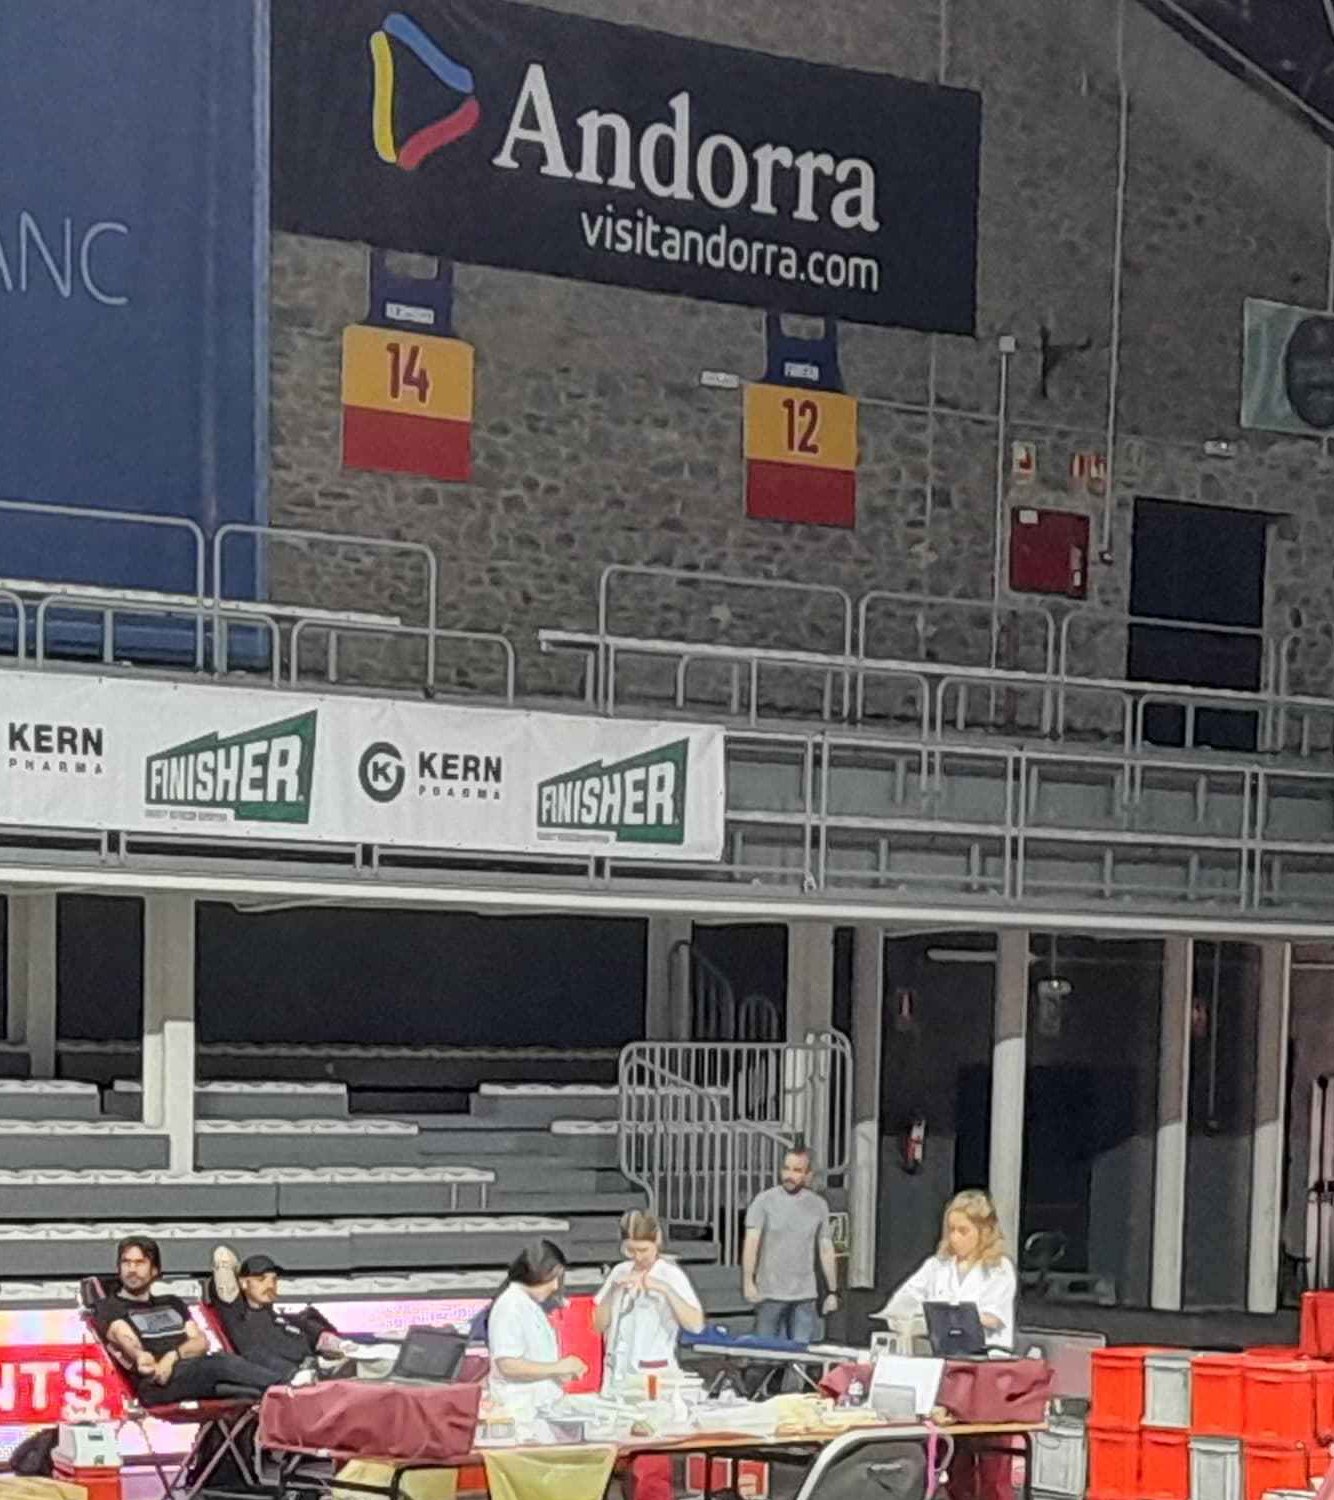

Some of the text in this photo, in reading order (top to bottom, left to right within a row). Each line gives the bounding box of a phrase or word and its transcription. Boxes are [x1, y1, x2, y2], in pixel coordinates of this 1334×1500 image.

[491, 63, 880, 232] Andorra
[581, 203, 879, 293] visitandorra.com
[386, 342, 431, 404] 14
[782, 398, 820, 455] 12
[8, 722, 103, 756] KERN
[8, 757, 103, 775] PHARMA
[150, 735, 302, 802] FINISHER
[418, 751, 502, 783] KERN
[540, 760, 678, 826] FINISHER
